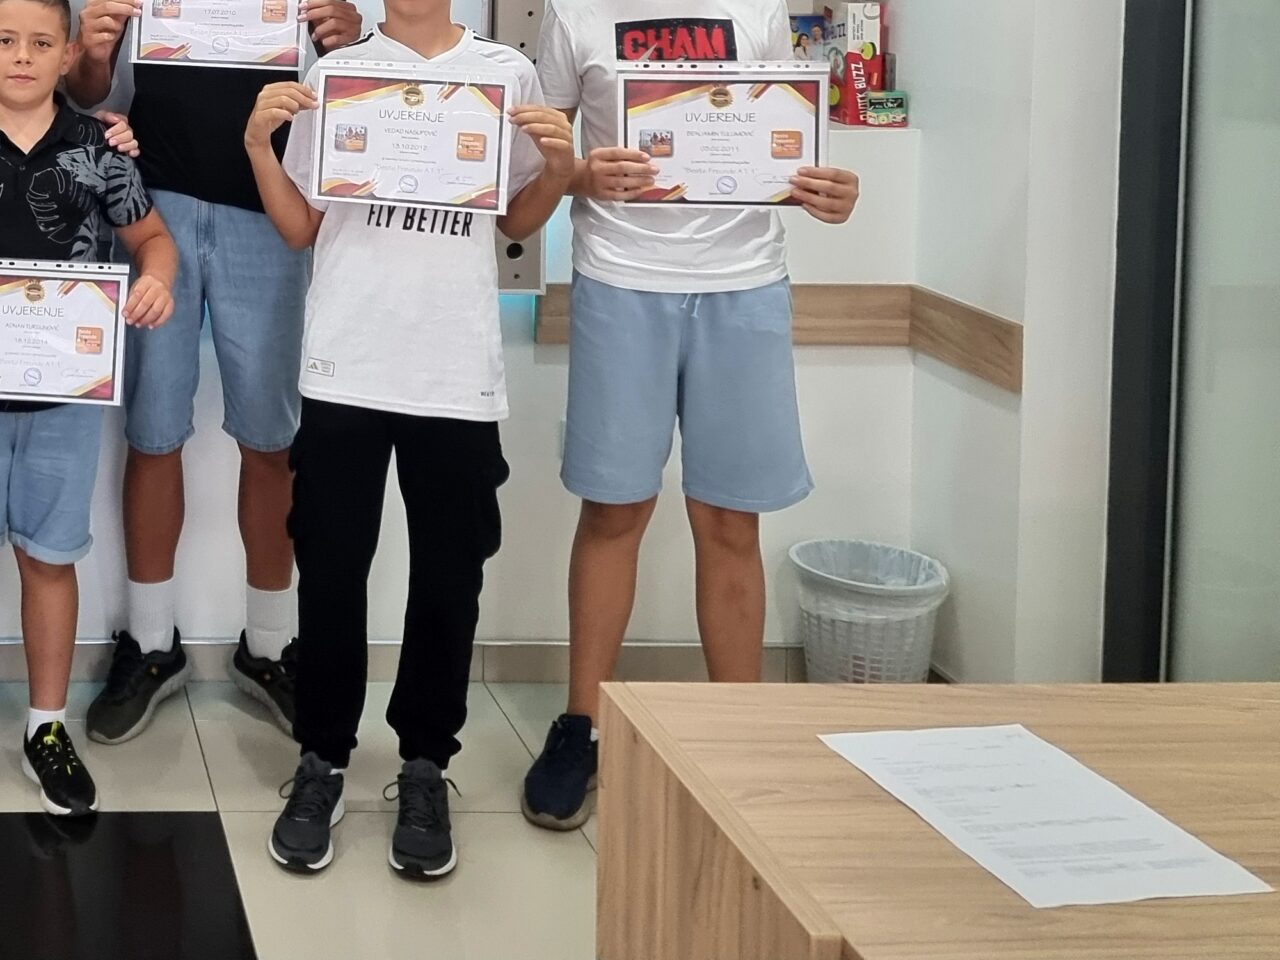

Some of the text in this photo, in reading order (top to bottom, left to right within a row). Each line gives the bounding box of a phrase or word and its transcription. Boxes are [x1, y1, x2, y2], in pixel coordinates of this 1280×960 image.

[622, 25, 726, 61] CHAM
[851, 61, 867, 90] BUZZ
[379, 109, 445, 123] UVJERENJE
[685, 112, 756, 122] UVJERENJE
[366, 204, 473, 238] FLY BETTER
[2, 305, 64, 318] UVJERENJE
